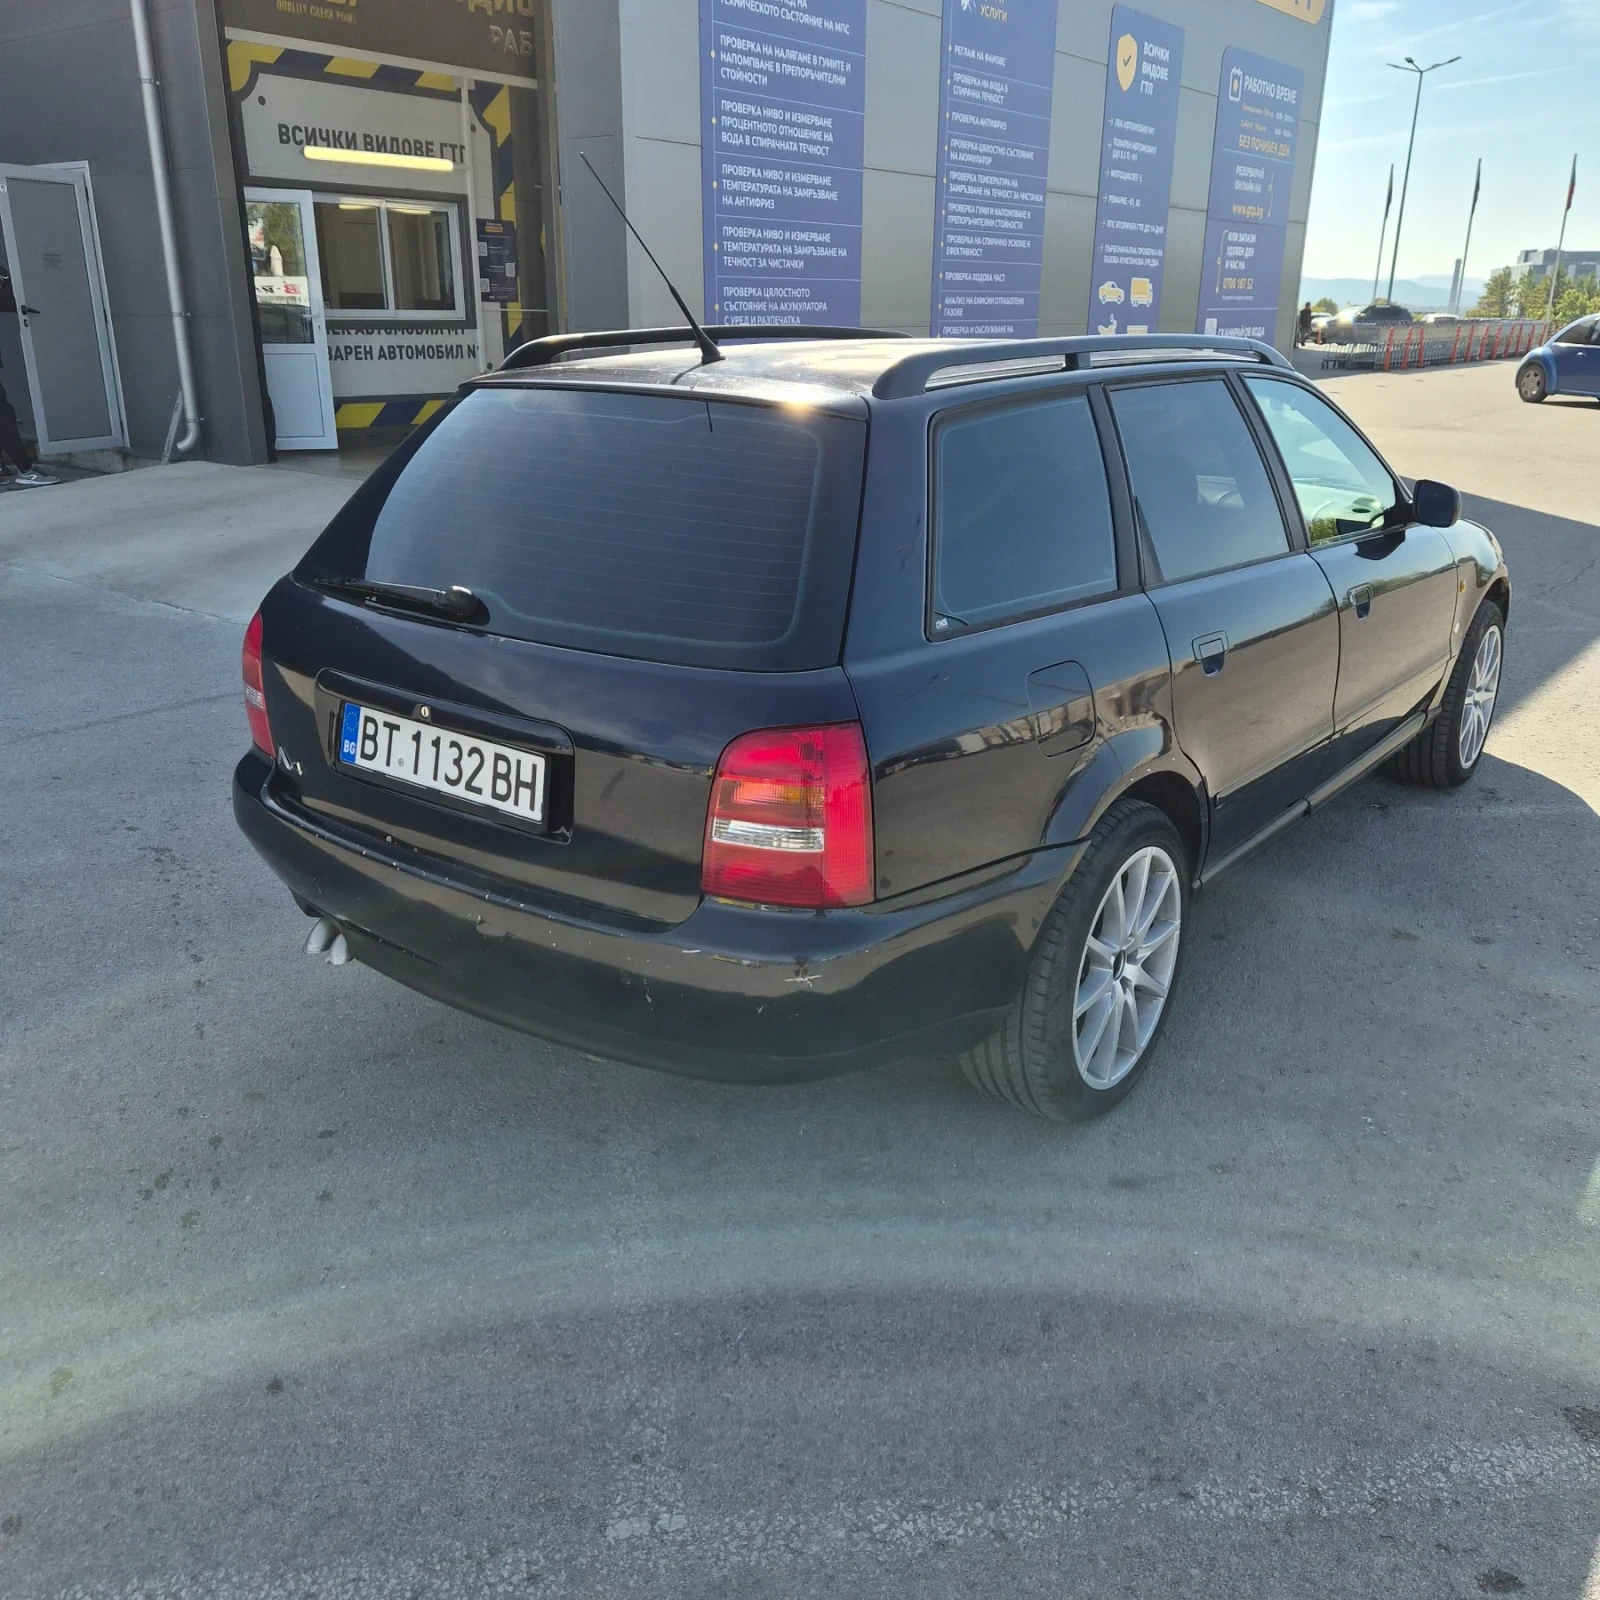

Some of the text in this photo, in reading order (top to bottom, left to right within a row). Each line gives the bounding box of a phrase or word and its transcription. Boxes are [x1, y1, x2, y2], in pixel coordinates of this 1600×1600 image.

[781, 8, 823, 28] СЪСТОЯНИЕ
[824, 19, 834, 31] НА
[835, 21, 850, 35] МПС
[720, 35, 851, 73] ПРОВЕРКА НА НАЛЯГАНЕ В ГУМИТЕ И
[977, 50, 984, 61] НА
[1143, 42, 1169, 62] ВСИЧКИ
[721, 52, 846, 86] НАПОМПВАНЕ В ПРЕПОРЪЧИТЕЛНИ
[721, 66, 768, 86] СТОЙНОСТИ
[1142, 61, 1169, 80] ВИДОВЕ
[954, 72, 980, 87] ПРОВЕРКА
[982, 78, 989, 89] НА
[1140, 80, 1153, 95] ГТП
[1244, 75, 1297, 104] РАБОТНО ВРЕМЕ
[982, 91, 1004, 104] ТЕЧНОСТ
[721, 100, 833, 128] ПРОВЕРКА НИВО И ИЗМЕРВАНЕ
[952, 112, 1007, 130] ПРОВЕРКА АНТИФРИЗ
[722, 116, 833, 143] ПРОЦЕНТНОТО ОТНОШЕНИЕ НА
[277, 123, 357, 149] ВСИЧКИ
[362, 133, 434, 158] ВИДОВЕ
[722, 132, 829, 156] ВОДА В СПИРАЧНАТА ТЕЧНОСТ
[951, 139, 978, 151] ПРОВЕРКА
[1239, 134, 1250, 148] БЕЗ
[950, 151, 958, 160] НА
[722, 164, 832, 186] ПРОВЕРКА НИВО И ИЗМЕРВАНЕ
[950, 171, 977, 183] ПРОВЕРКА
[722, 180, 838, 200] ТЕМПЕРАТУРАТА НА ЗАМРЪЗВАНЕ
[949, 183, 983, 195] ЗАМРЪЗВАНЕ
[984, 187, 990, 196] НА
[992, 188, 1012, 198] ТЕЧНОСТ
[723, 195, 775, 209] НА АНТИФРИЗ
[948, 203, 975, 214] ПРОВЕРКА
[723, 226, 831, 243] ПРОВЕРКА НИВО И ИЗМЕРВАНЕ
[947, 235, 974, 245] ПРОВЕРКА
[975, 237, 981, 245] НА
[723, 242, 847, 257] ТЕМПЕРАТУРАТА НА ЗАМРЪЗВАНЕ НА
[946, 247, 983, 256] ЕФЕКТИВНОСТ
[723, 256, 804, 269] ТЕЧНОСТ ЗА ЧИСТАЧКИ
[945, 272, 972, 281] ПРОВЕРКА
[724, 287, 810, 299] ПРОВЕРКА ЦЯЛОСТНОТО
[724, 302, 828, 312] СЪСТОЯНИЕ НА АКУМУЛАТОРА
[966, 297, 973, 305] НА
[944, 308, 963, 316] ГАЗОВЕ
[724, 316, 801, 325] С УРЕД И РАЗПЕЧАТКА
[943, 326, 969, 334] ПРОВЕРКА
[328, 344, 479, 361] ВАРЕН АВТОМОБИЛ N
[343, 740, 356, 755] BG
[360, 715, 538, 812] BT 1132 BH
